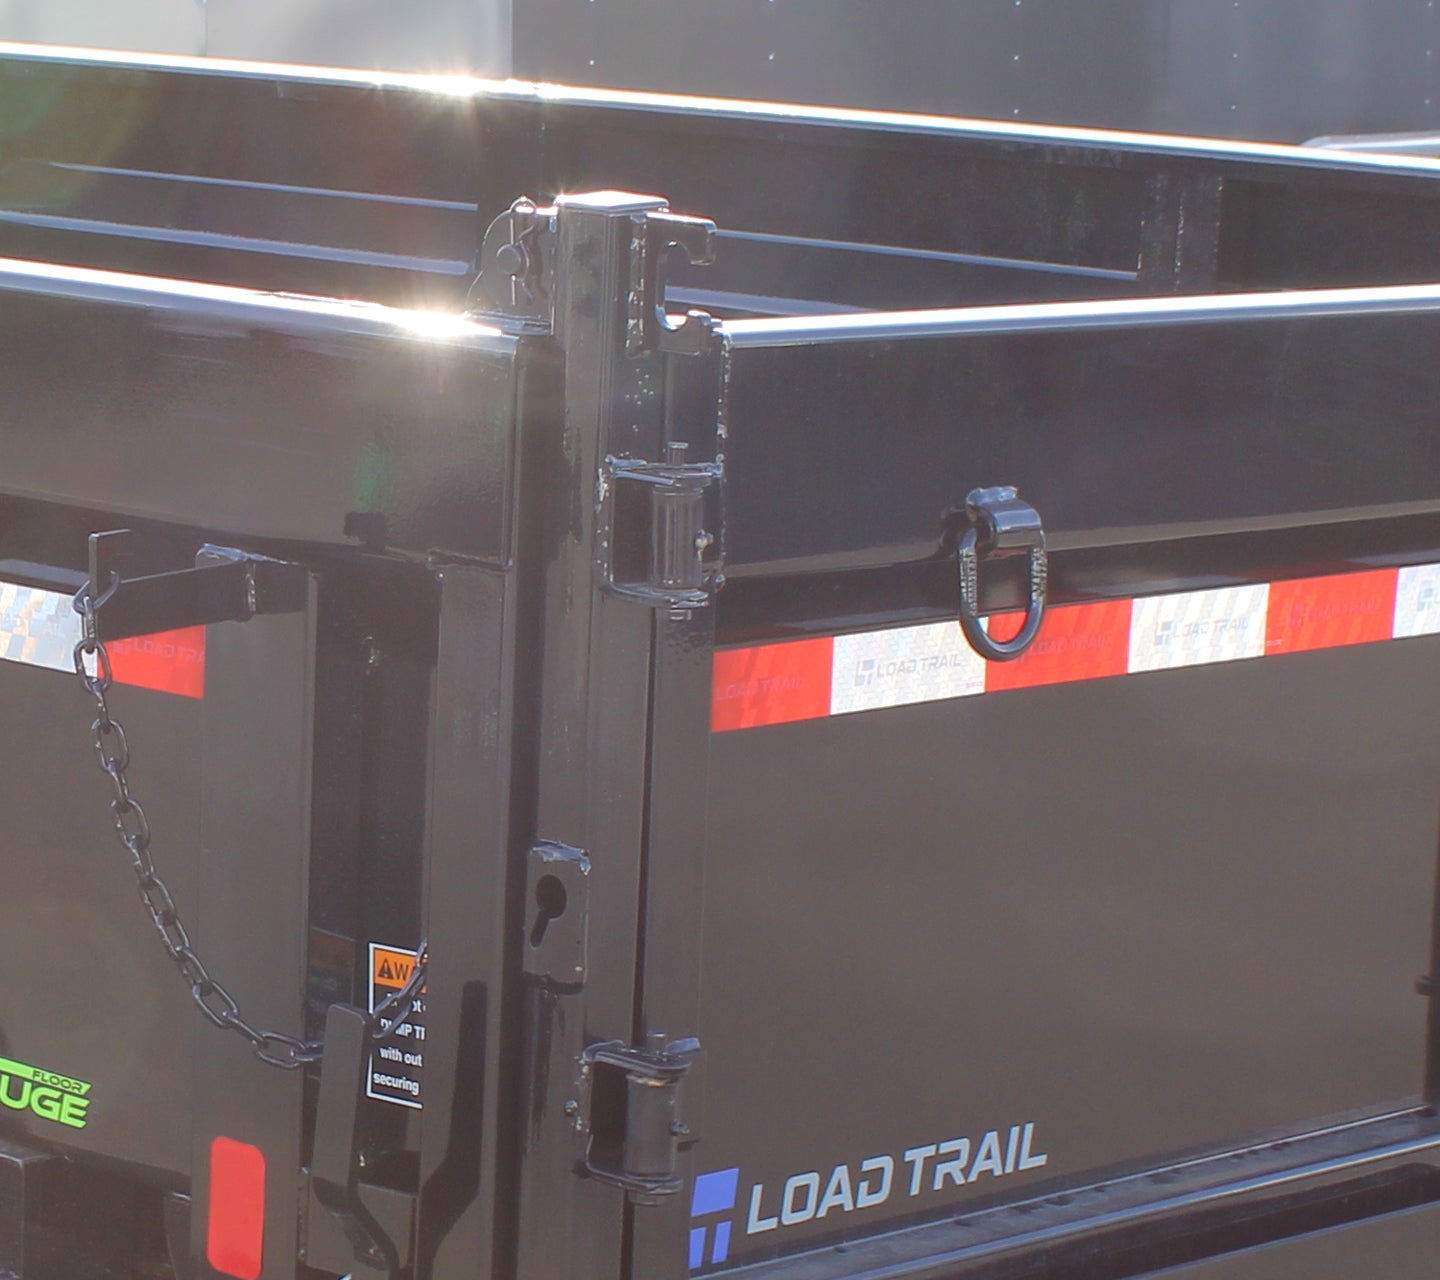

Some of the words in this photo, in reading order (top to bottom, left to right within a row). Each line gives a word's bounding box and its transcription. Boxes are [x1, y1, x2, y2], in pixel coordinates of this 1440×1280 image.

[380, 1047, 402, 1062] with
[403, 1053, 423, 1067] out
[32, 1070, 84, 1094] FLOOR
[373, 1072, 419, 1096] securing
